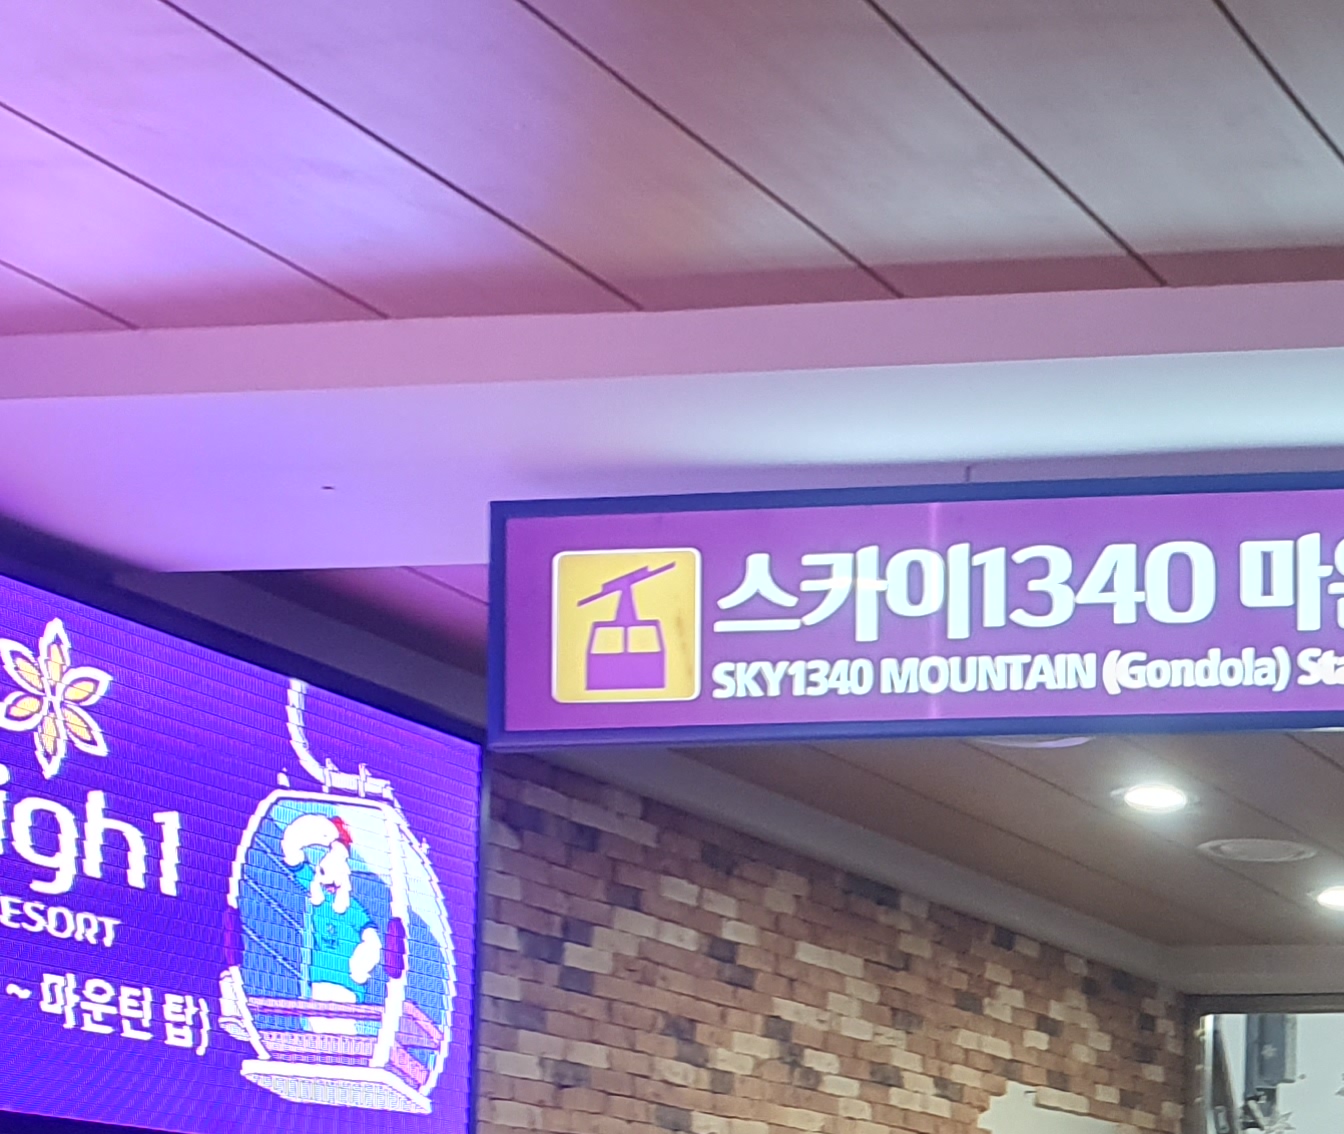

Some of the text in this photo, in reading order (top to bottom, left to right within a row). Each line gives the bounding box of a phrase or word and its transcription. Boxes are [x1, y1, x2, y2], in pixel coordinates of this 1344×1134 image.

[712, 540, 1217, 642] 스카이1340
[711, 658, 874, 698] SKY1340
[880, 652, 1097, 695] MOUNTAIN
[1102, 646, 1291, 695] (Gondola)
[40, 973, 153, 1041] 마운틴
[163, 992, 211, 1056] 탑)
